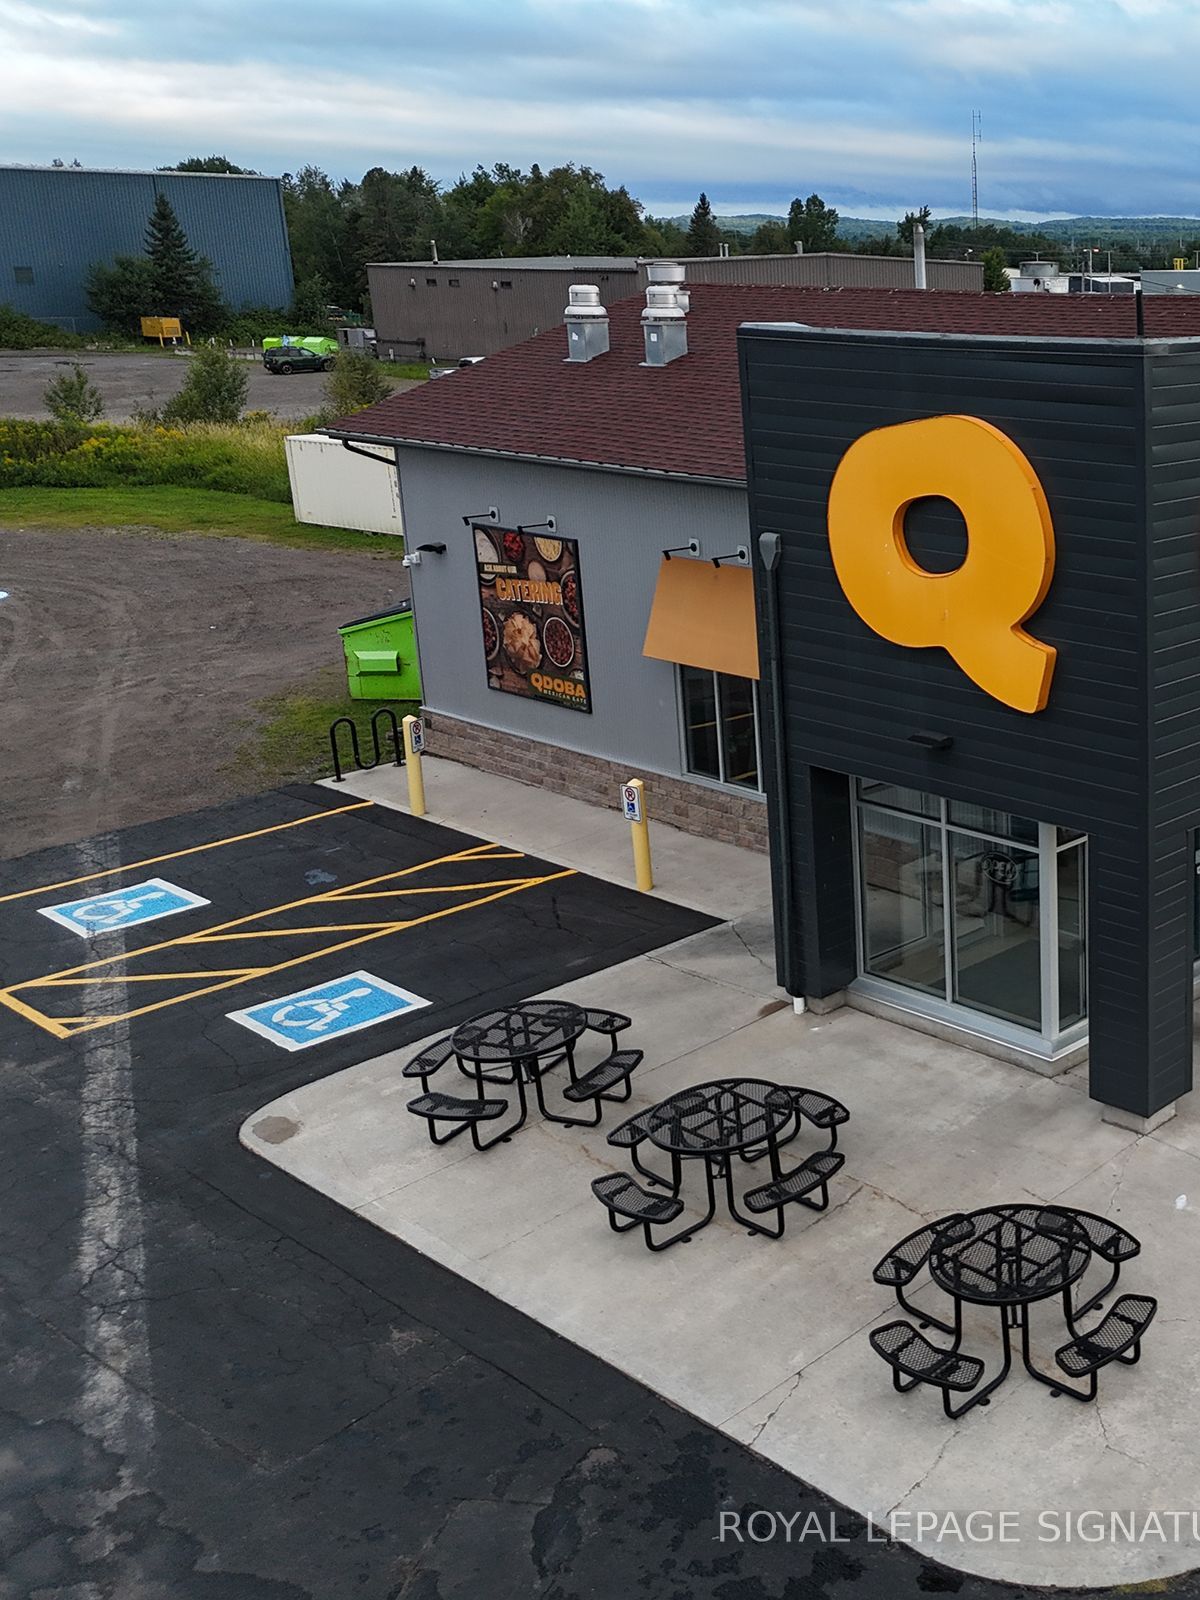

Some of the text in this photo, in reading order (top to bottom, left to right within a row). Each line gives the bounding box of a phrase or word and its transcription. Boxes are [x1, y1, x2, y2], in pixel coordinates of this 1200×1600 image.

[827, 414, 1056, 714] Q
[495, 576, 563, 606] CATERING
[530, 672, 587, 699] QDOBA
